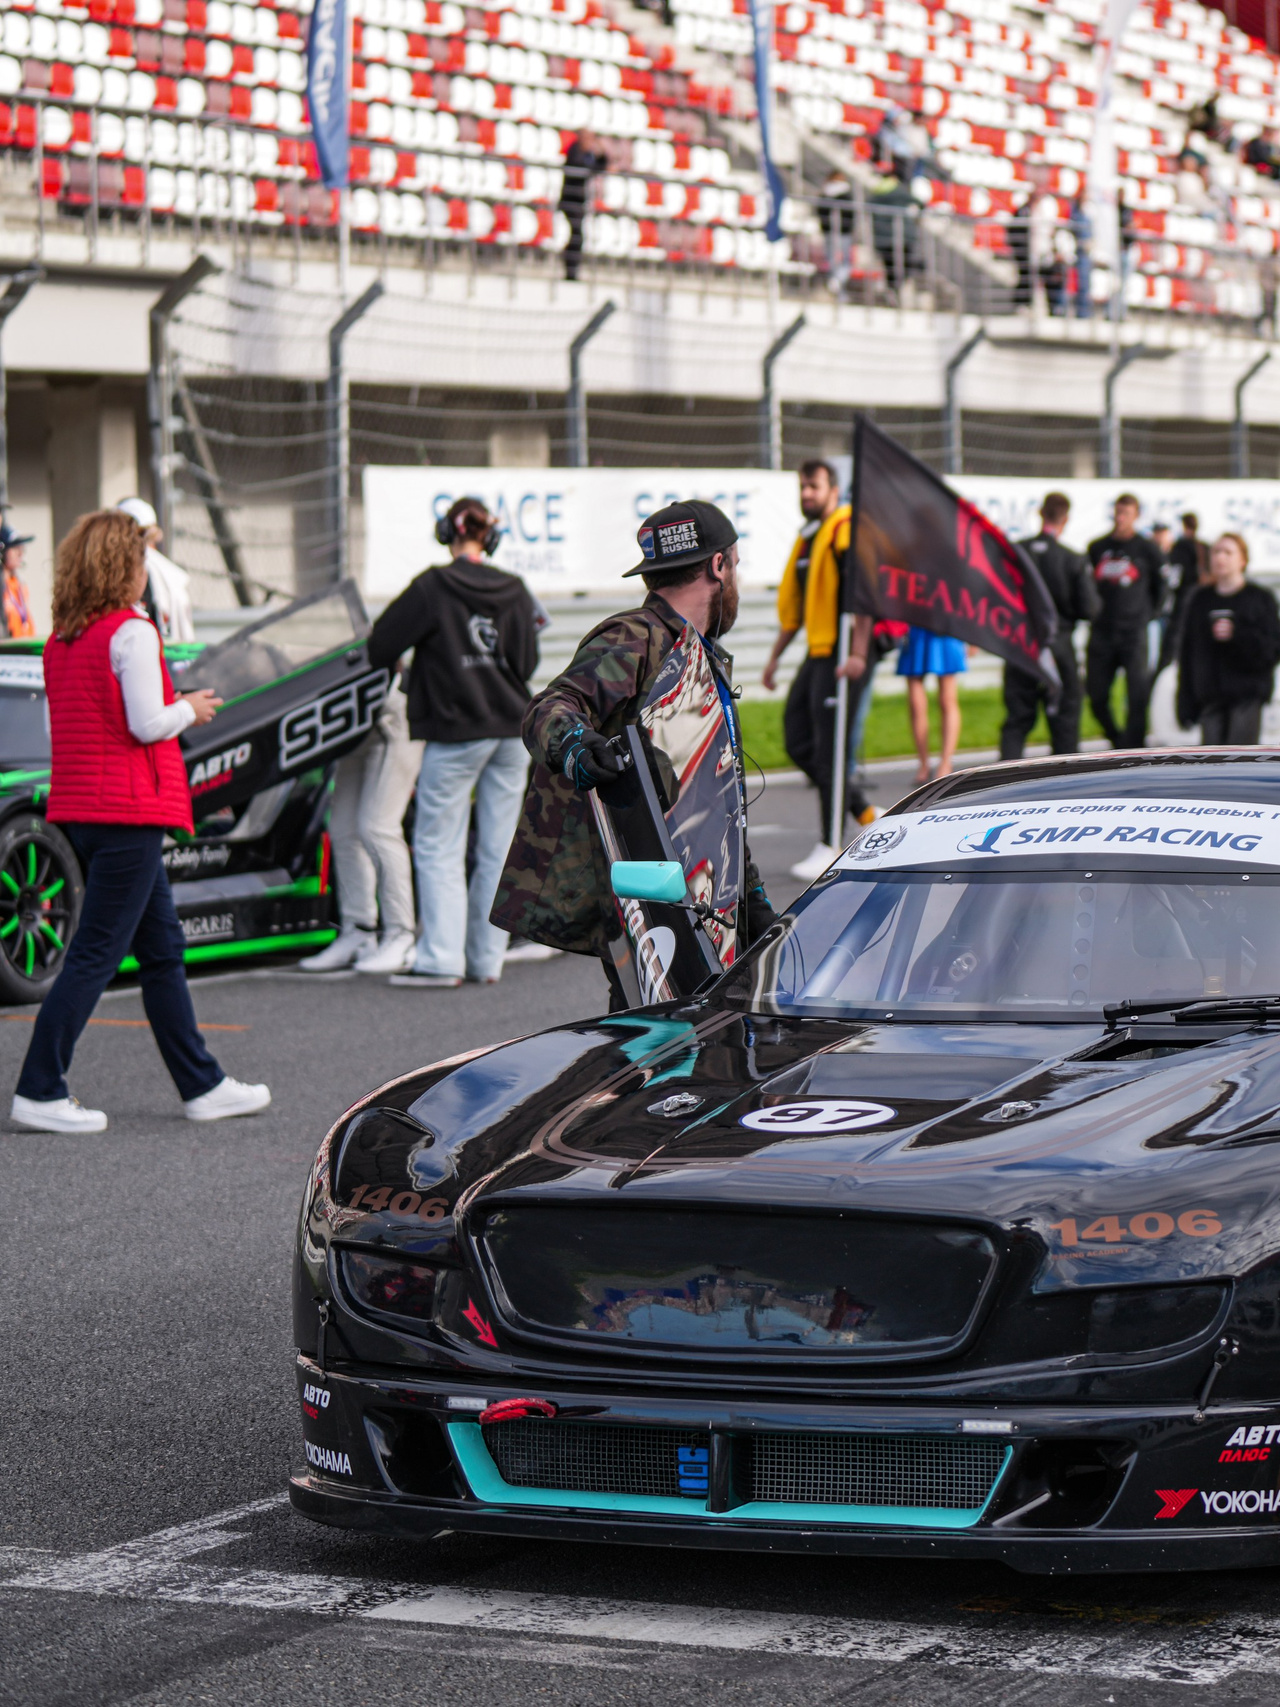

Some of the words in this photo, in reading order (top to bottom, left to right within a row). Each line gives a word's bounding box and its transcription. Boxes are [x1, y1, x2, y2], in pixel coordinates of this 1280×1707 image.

[658, 522, 696, 538] MITJET
[660, 531, 699, 547] SERIES
[662, 540, 699, 554] RUSSIA
[879, 564, 1040, 660] TEAMGA
[279, 667, 390, 770] SSF
[917, 806, 1051, 825] Российская
[1056, 804, 1127, 815] серия
[1131, 804, 1265, 819] кольцевых
[1010, 826, 1103, 845] SMP
[1103, 825, 1263, 852] RACING
[758, 1107, 884, 1126] 97
[348, 1183, 450, 1223] 1406
[1050, 1209, 1222, 1247] 1406
[1087, 1246, 1130, 1258] ACADEMY
[304, 1383, 331, 1408] АВТО
[1218, 1447, 1271, 1463] ПЛЮС
